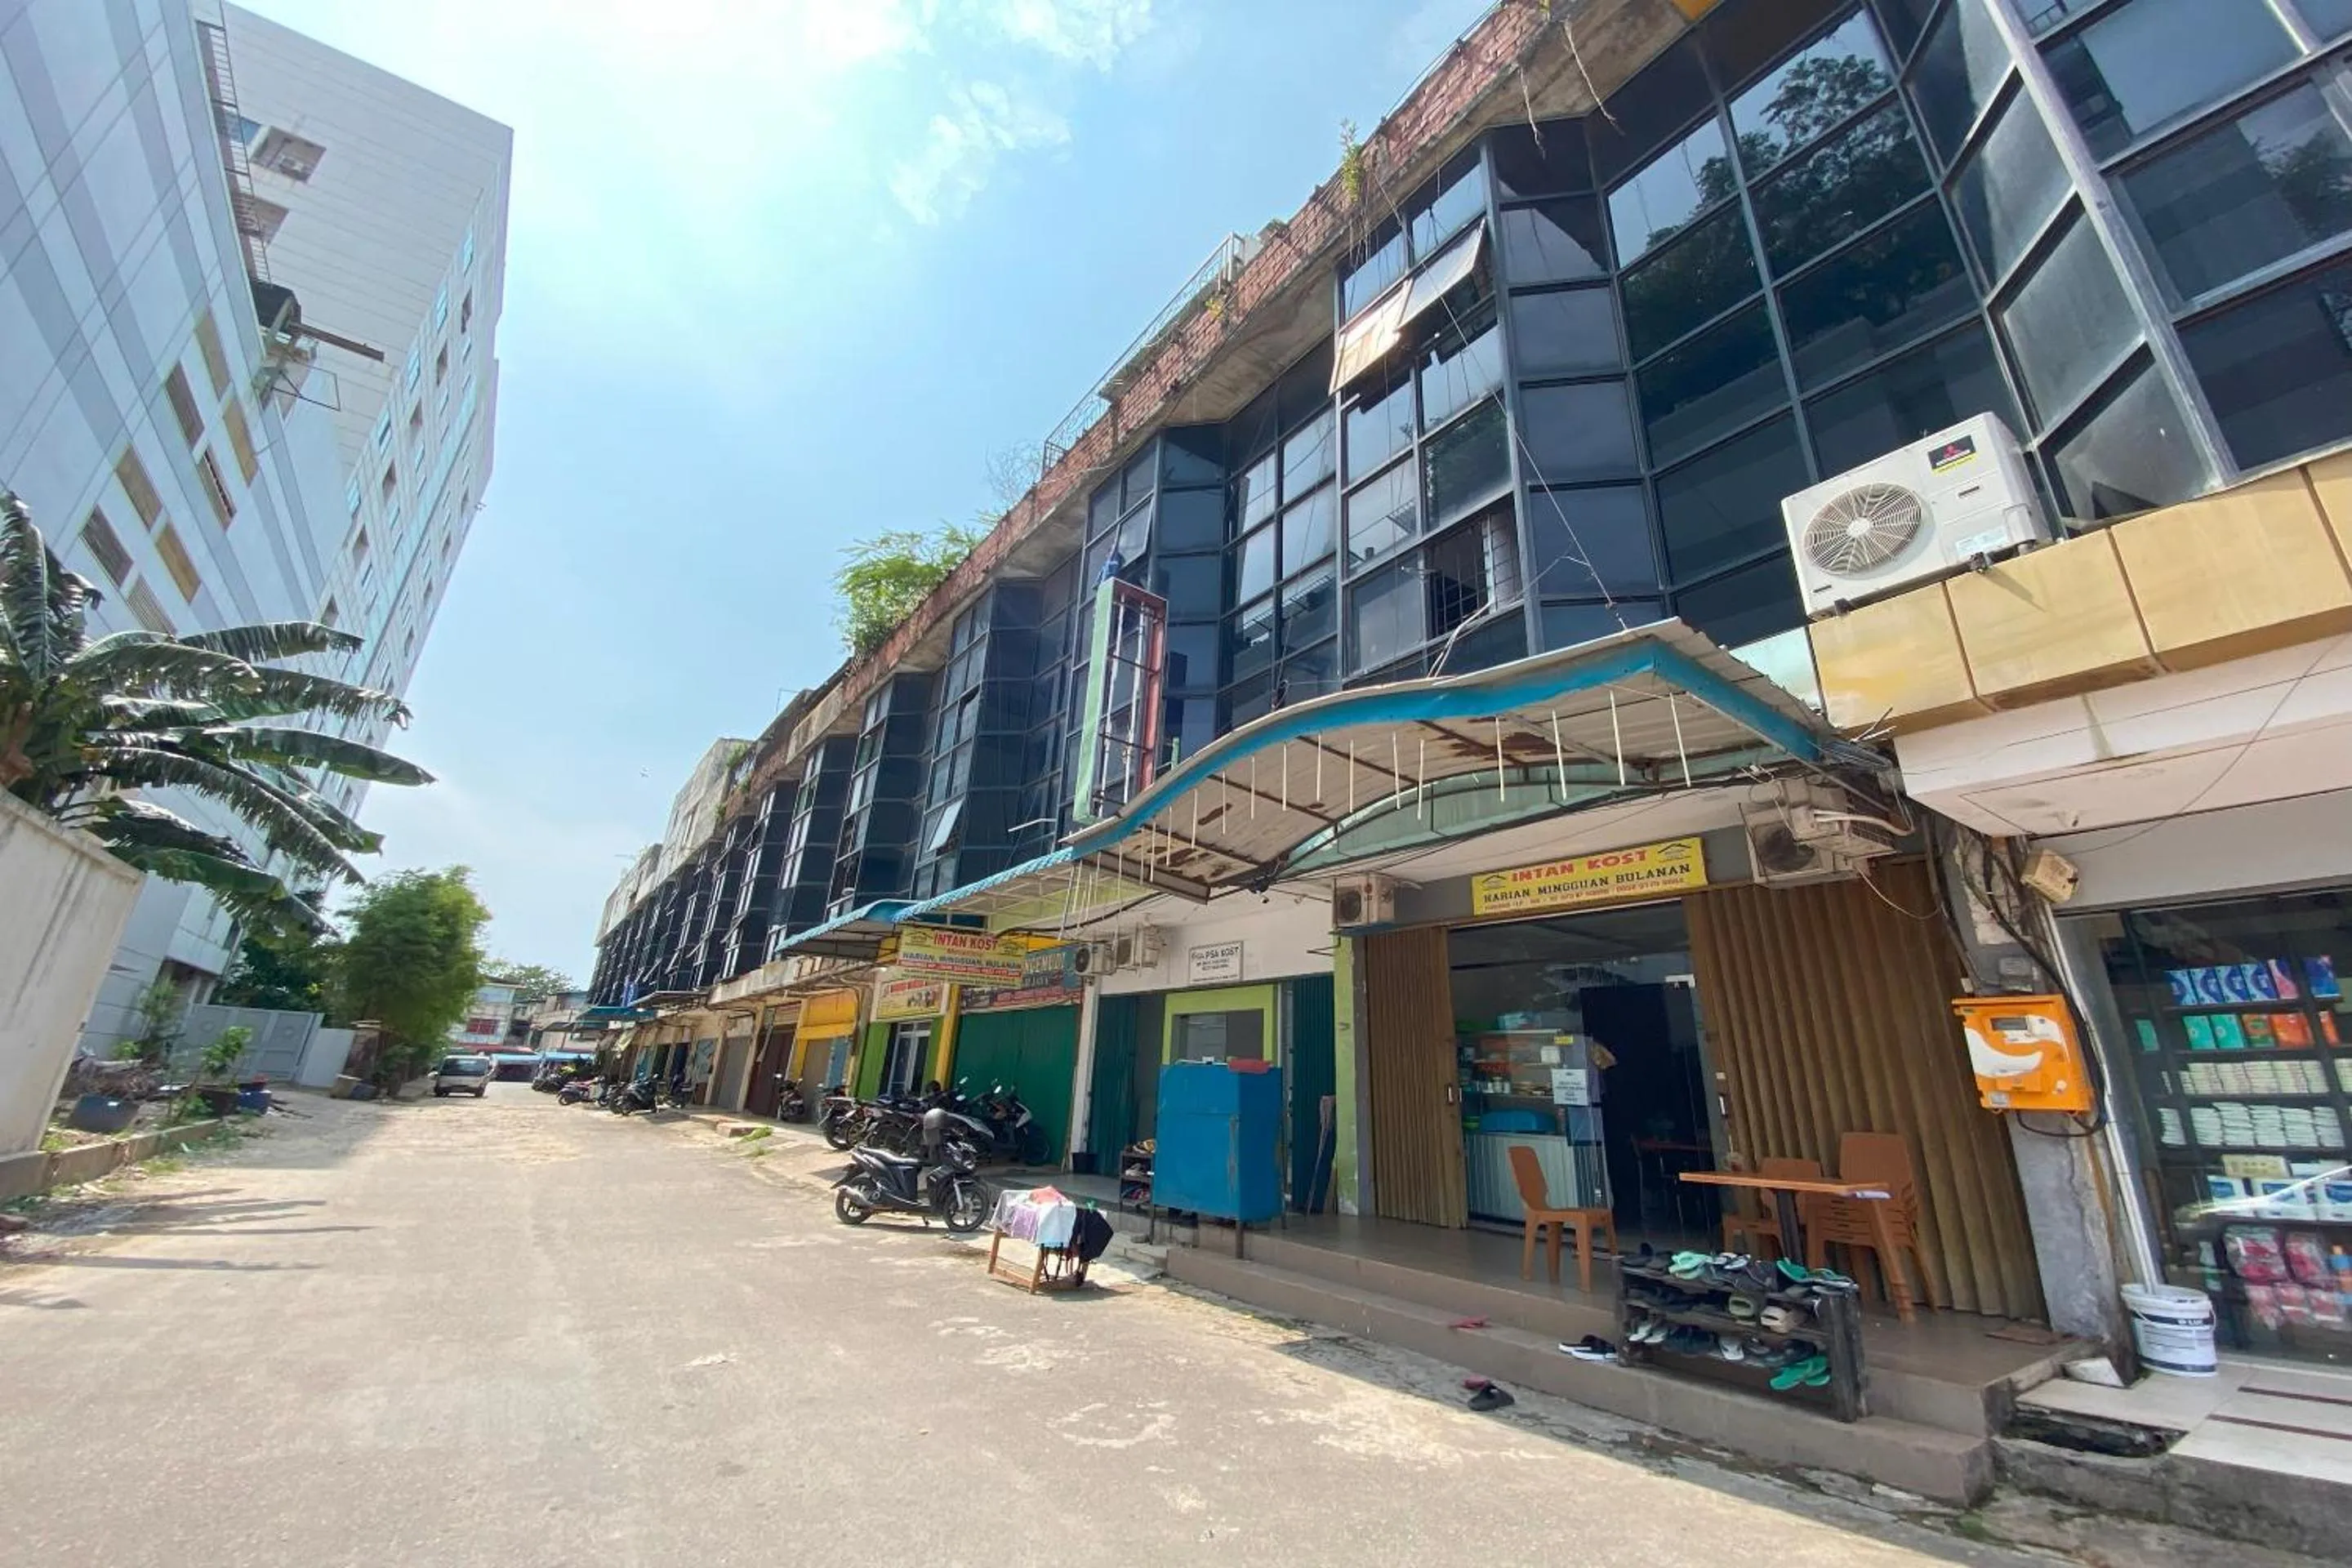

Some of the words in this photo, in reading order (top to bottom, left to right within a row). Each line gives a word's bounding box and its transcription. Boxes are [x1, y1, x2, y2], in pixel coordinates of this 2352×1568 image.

[1512, 862, 1575, 882] INTAN
[1587, 849, 1647, 870] KOST
[1484, 889, 1530, 902] HARIAN
[1538, 876, 1608, 895] MINGGUAN
[1615, 863, 1690, 884] BULANAN
[933, 932, 967, 947] INTAN
[969, 937, 998, 951] KOST
